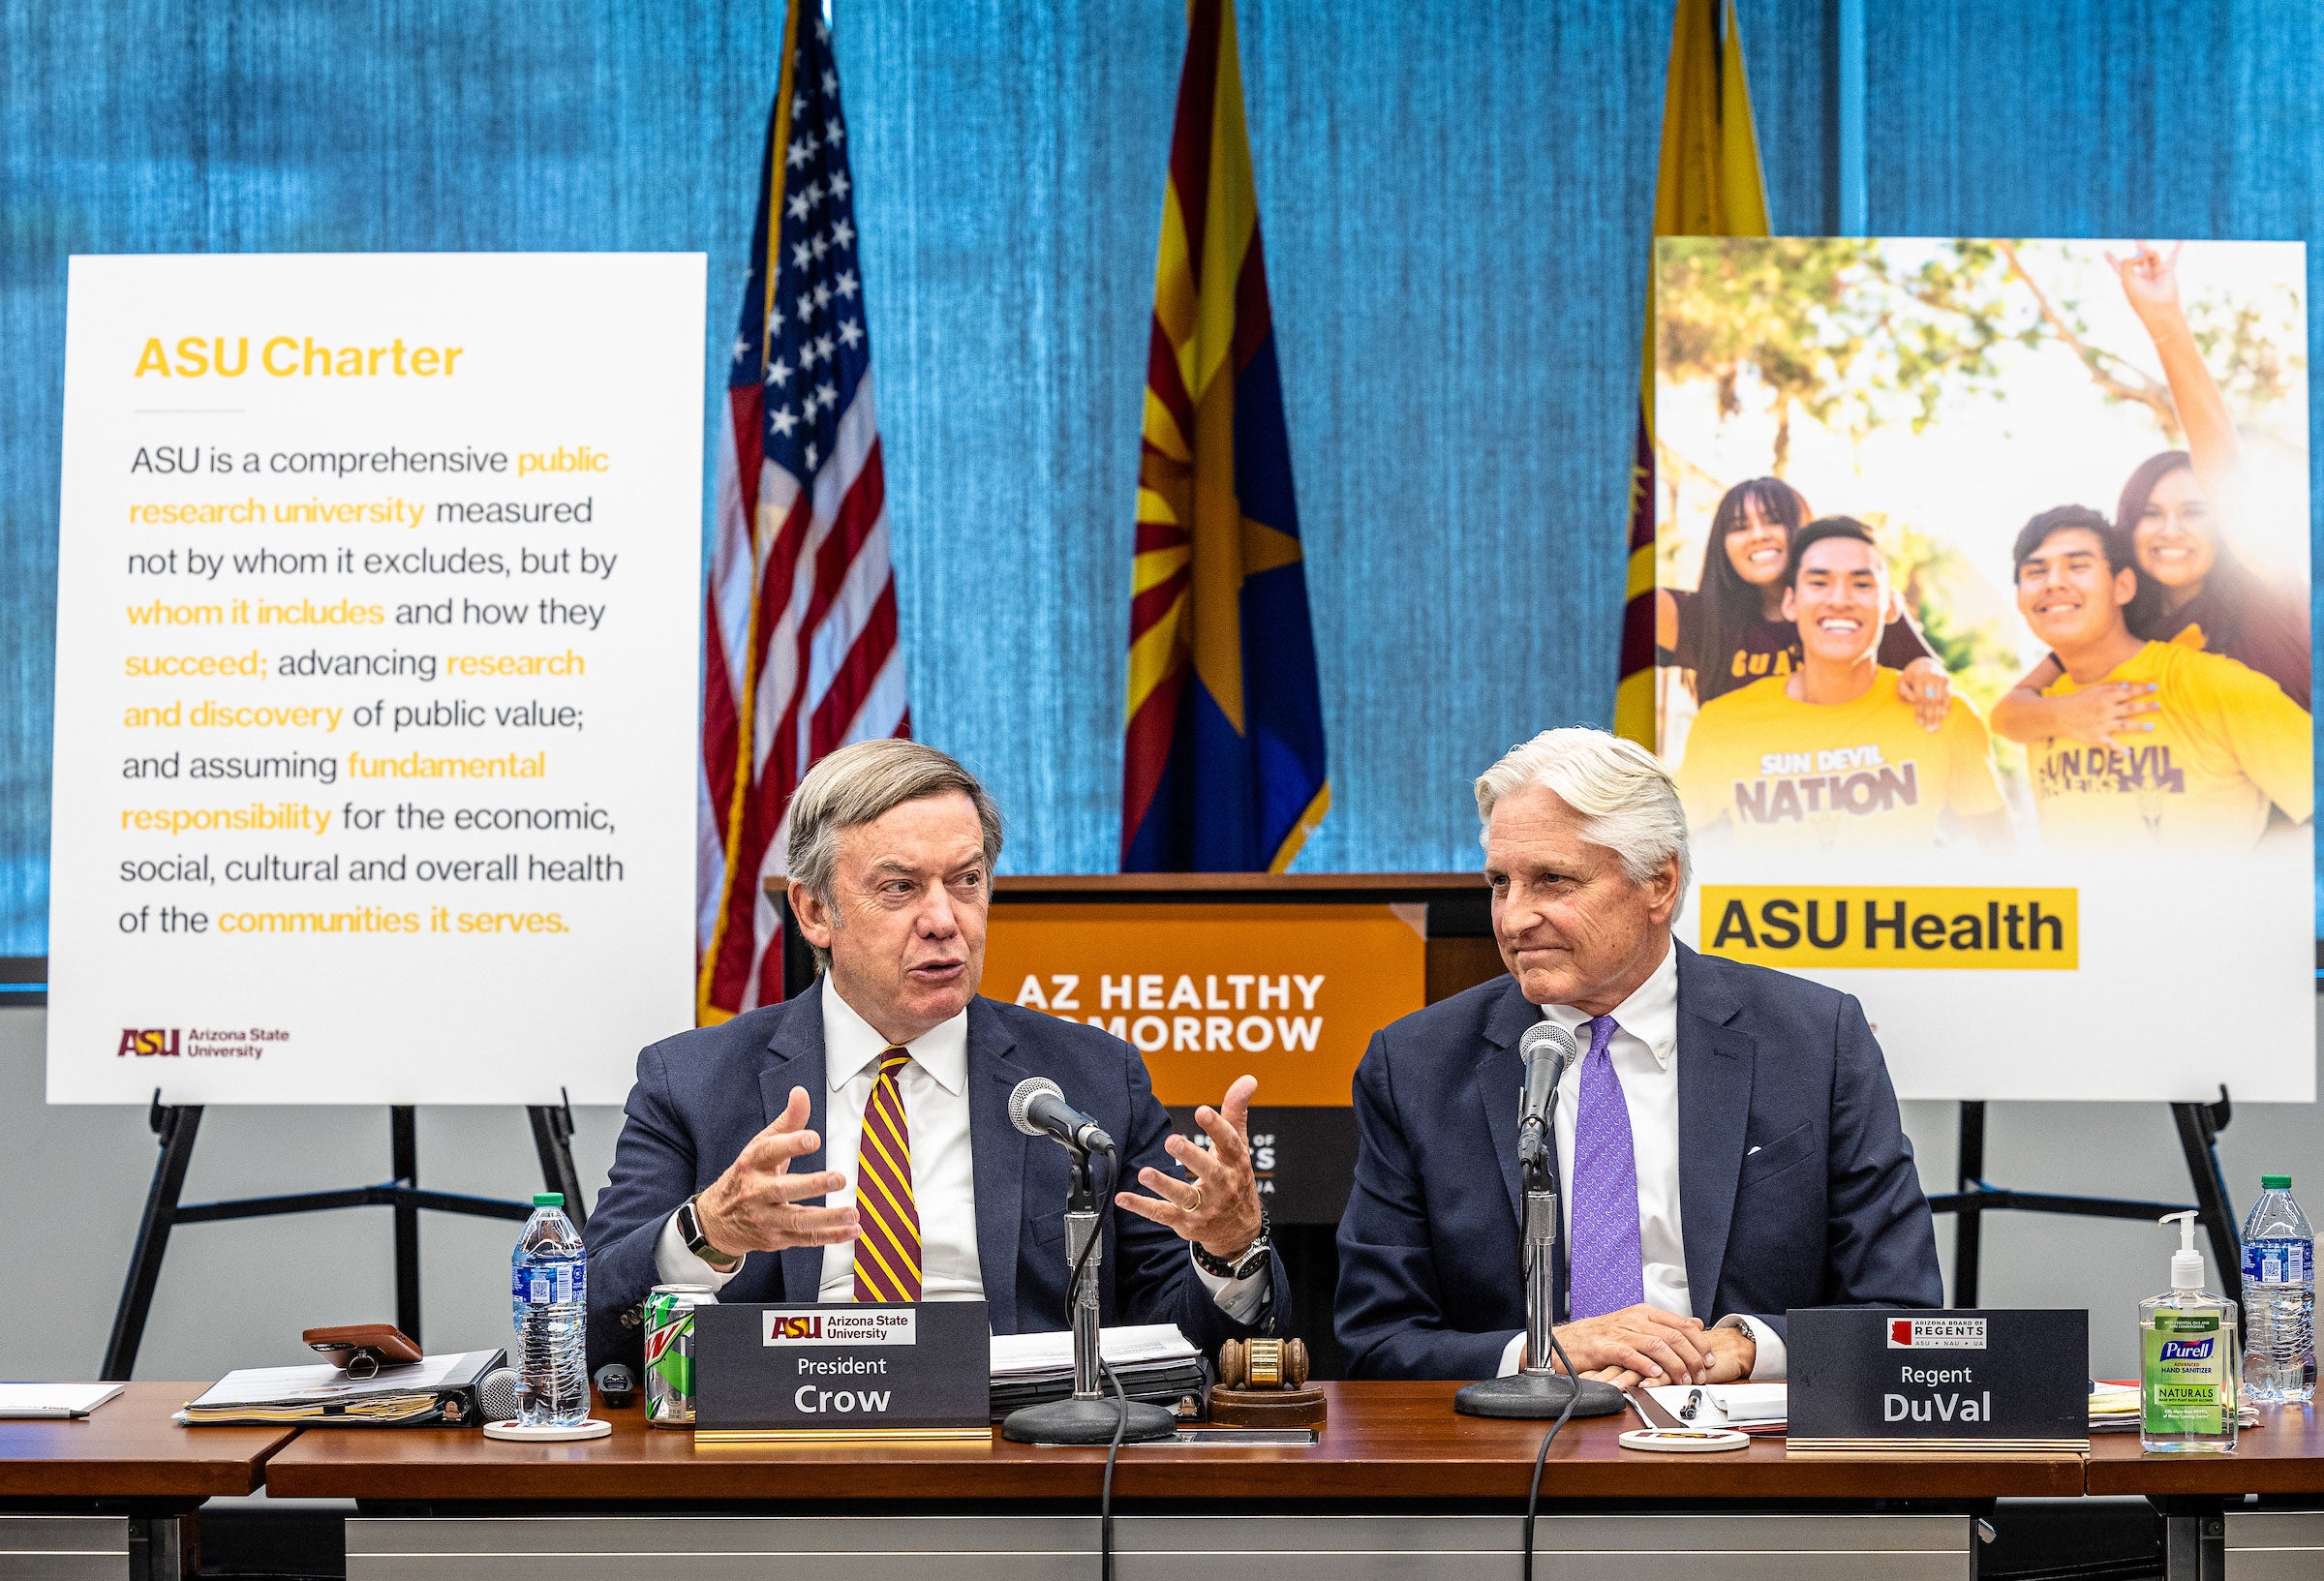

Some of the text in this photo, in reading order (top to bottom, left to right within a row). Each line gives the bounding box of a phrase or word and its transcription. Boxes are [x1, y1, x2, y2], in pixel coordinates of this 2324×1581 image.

[134, 336, 464, 378] ASU Charter
[131, 445, 610, 478] ASU is a comprehensive public
[129, 497, 593, 529] research university measured
[128, 547, 618, 580] not by whom it excludes, but by
[126, 598, 606, 630] whom it includes and how they
[125, 649, 586, 682] succeed; advancing research
[123, 699, 583, 733] and discovery of public value;
[122, 751, 546, 784] and assuming fundamental
[1759, 744, 1885, 775] SUN DEVIL
[2087, 745, 2172, 778] DEVIL
[1734, 760, 1918, 825] NATION
[121, 803, 615, 836] responsibility for the economic,
[120, 854, 624, 885] social, cultural and overall health
[118, 905, 570, 933] of the communities it serves.
[1712, 899, 2064, 951] ASU Health
[1015, 974, 1326, 1010] AZ HEALTHY
[117, 1029, 181, 1056] ASU
[188, 1028, 290, 1041] Arizona State
[1055, 1015, 1324, 1052] MORROW
[187, 1045, 263, 1060] University
[1253, 1134, 1275, 1147] OF
[772, 1317, 822, 1339] ASU
[827, 1315, 908, 1326] Arizona State
[827, 1328, 887, 1340] University
[1915, 1326, 1984, 1336] REGENTS
[2166, 1341, 2209, 1357] Purell
[798, 1356, 887, 1375] President
[1901, 1366, 1972, 1387] Regent
[794, 1384, 891, 1414] Crow
[1883, 1390, 1991, 1422] DuVal
[2158, 1388, 2214, 1397] NATURALS
